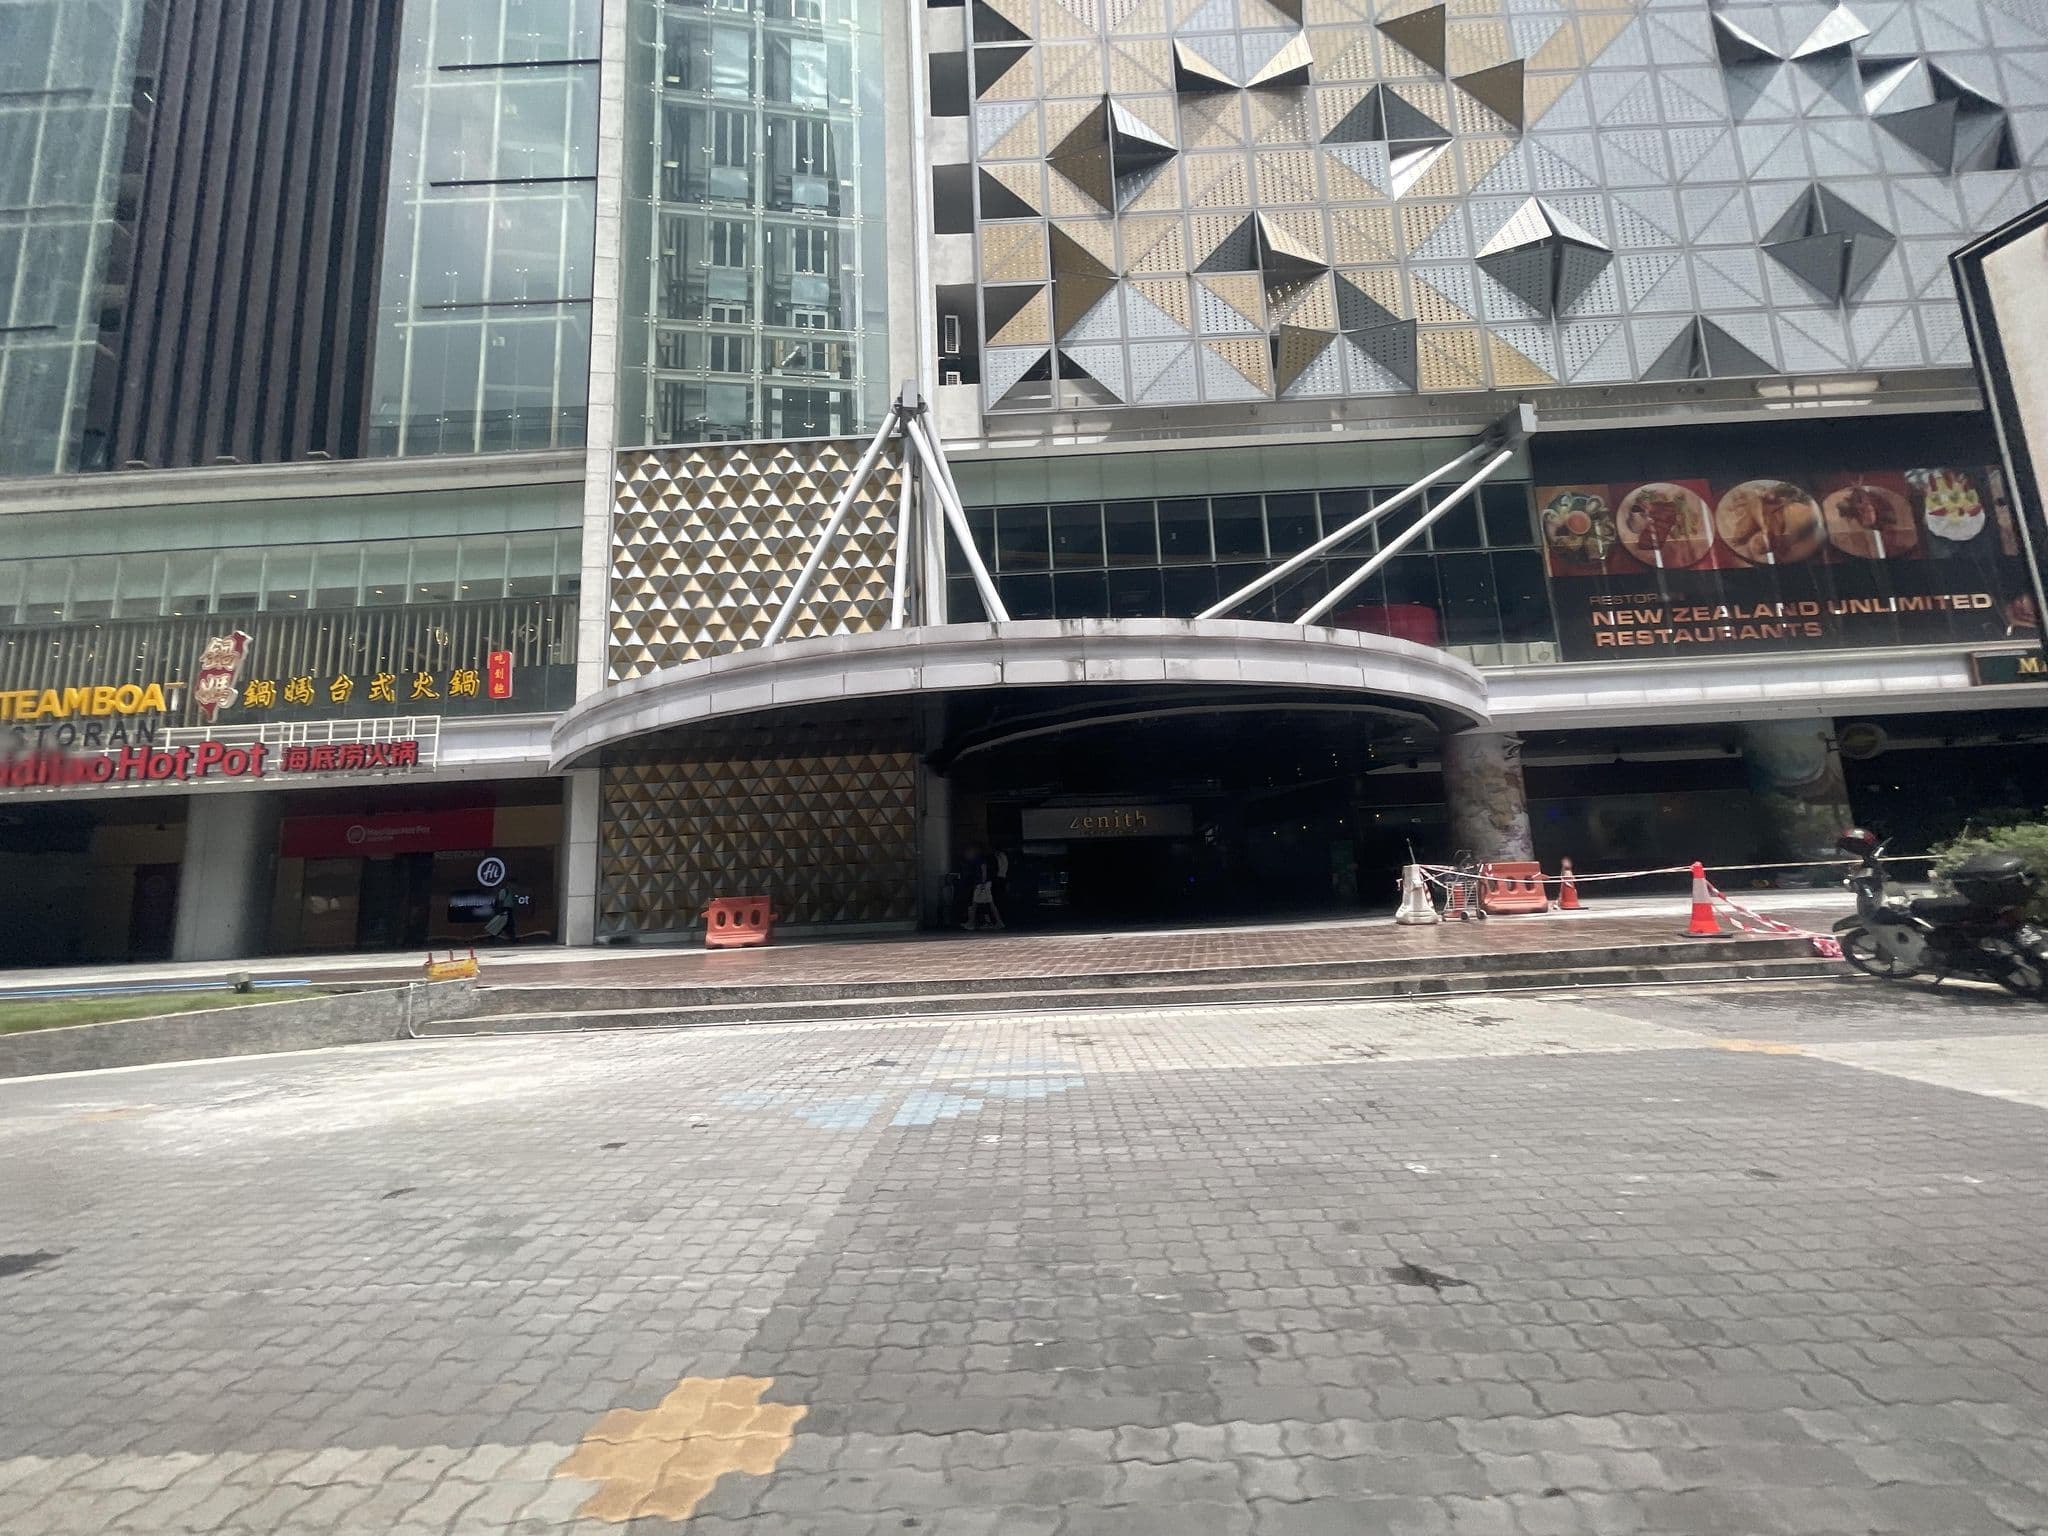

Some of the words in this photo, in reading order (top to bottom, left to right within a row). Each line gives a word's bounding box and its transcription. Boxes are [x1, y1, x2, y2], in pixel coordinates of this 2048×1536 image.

[1591, 607, 1664, 627] NEW
[1672, 600, 1820, 624] ZEALAND
[1828, 593, 1993, 616] UNLIMITED
[1595, 621, 1823, 647] RESTAURANTS
[243, 668, 481, 710] 鍋媽台式火鍋
[281, 740, 420, 773] 海底捞火锅
[1069, 809, 1147, 829] zenith
